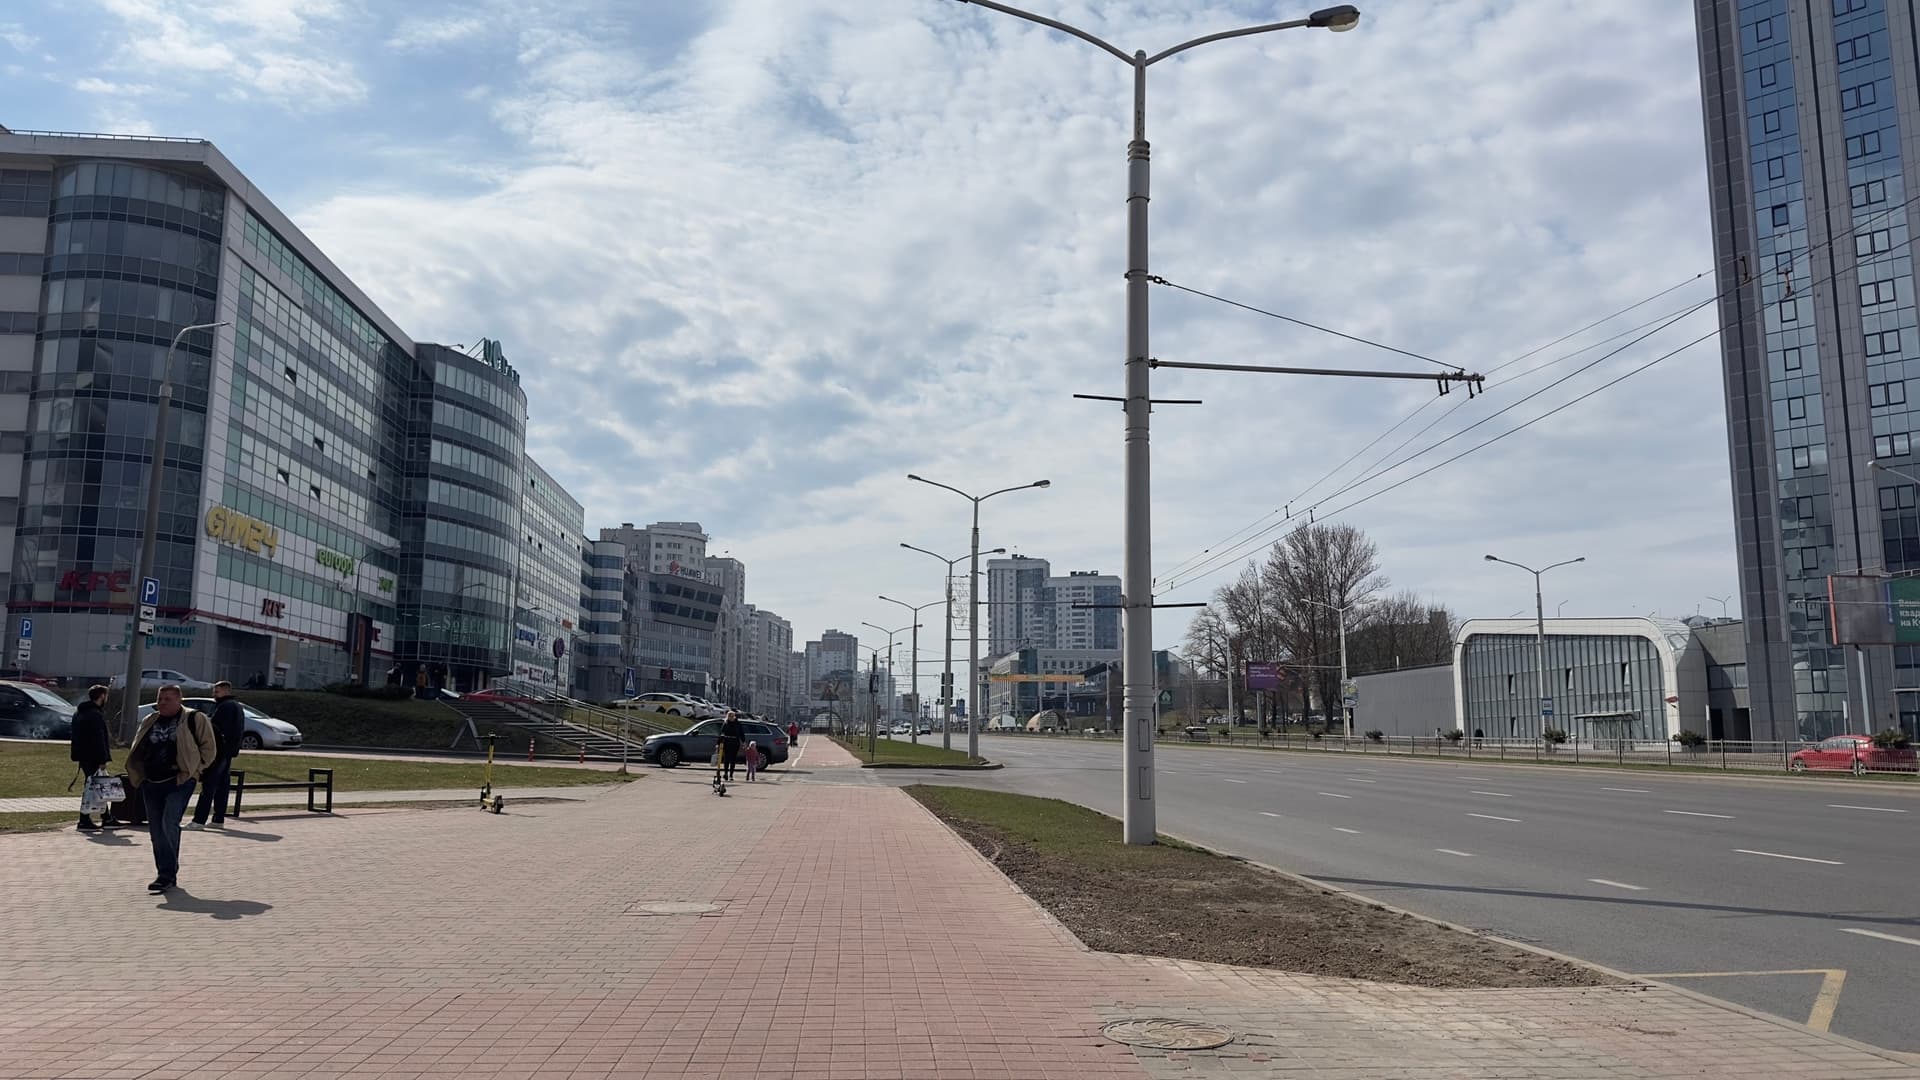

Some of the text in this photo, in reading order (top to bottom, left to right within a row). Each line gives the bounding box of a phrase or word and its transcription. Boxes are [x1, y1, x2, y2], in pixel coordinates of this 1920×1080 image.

[206, 505, 279, 557] GYM24
[60, 569, 131, 592] KFC
[681, 567, 702, 579] HUAWEI
[144, 580, 156, 601] P
[260, 598, 286, 619] KFC
[22, 620, 31, 636] P
